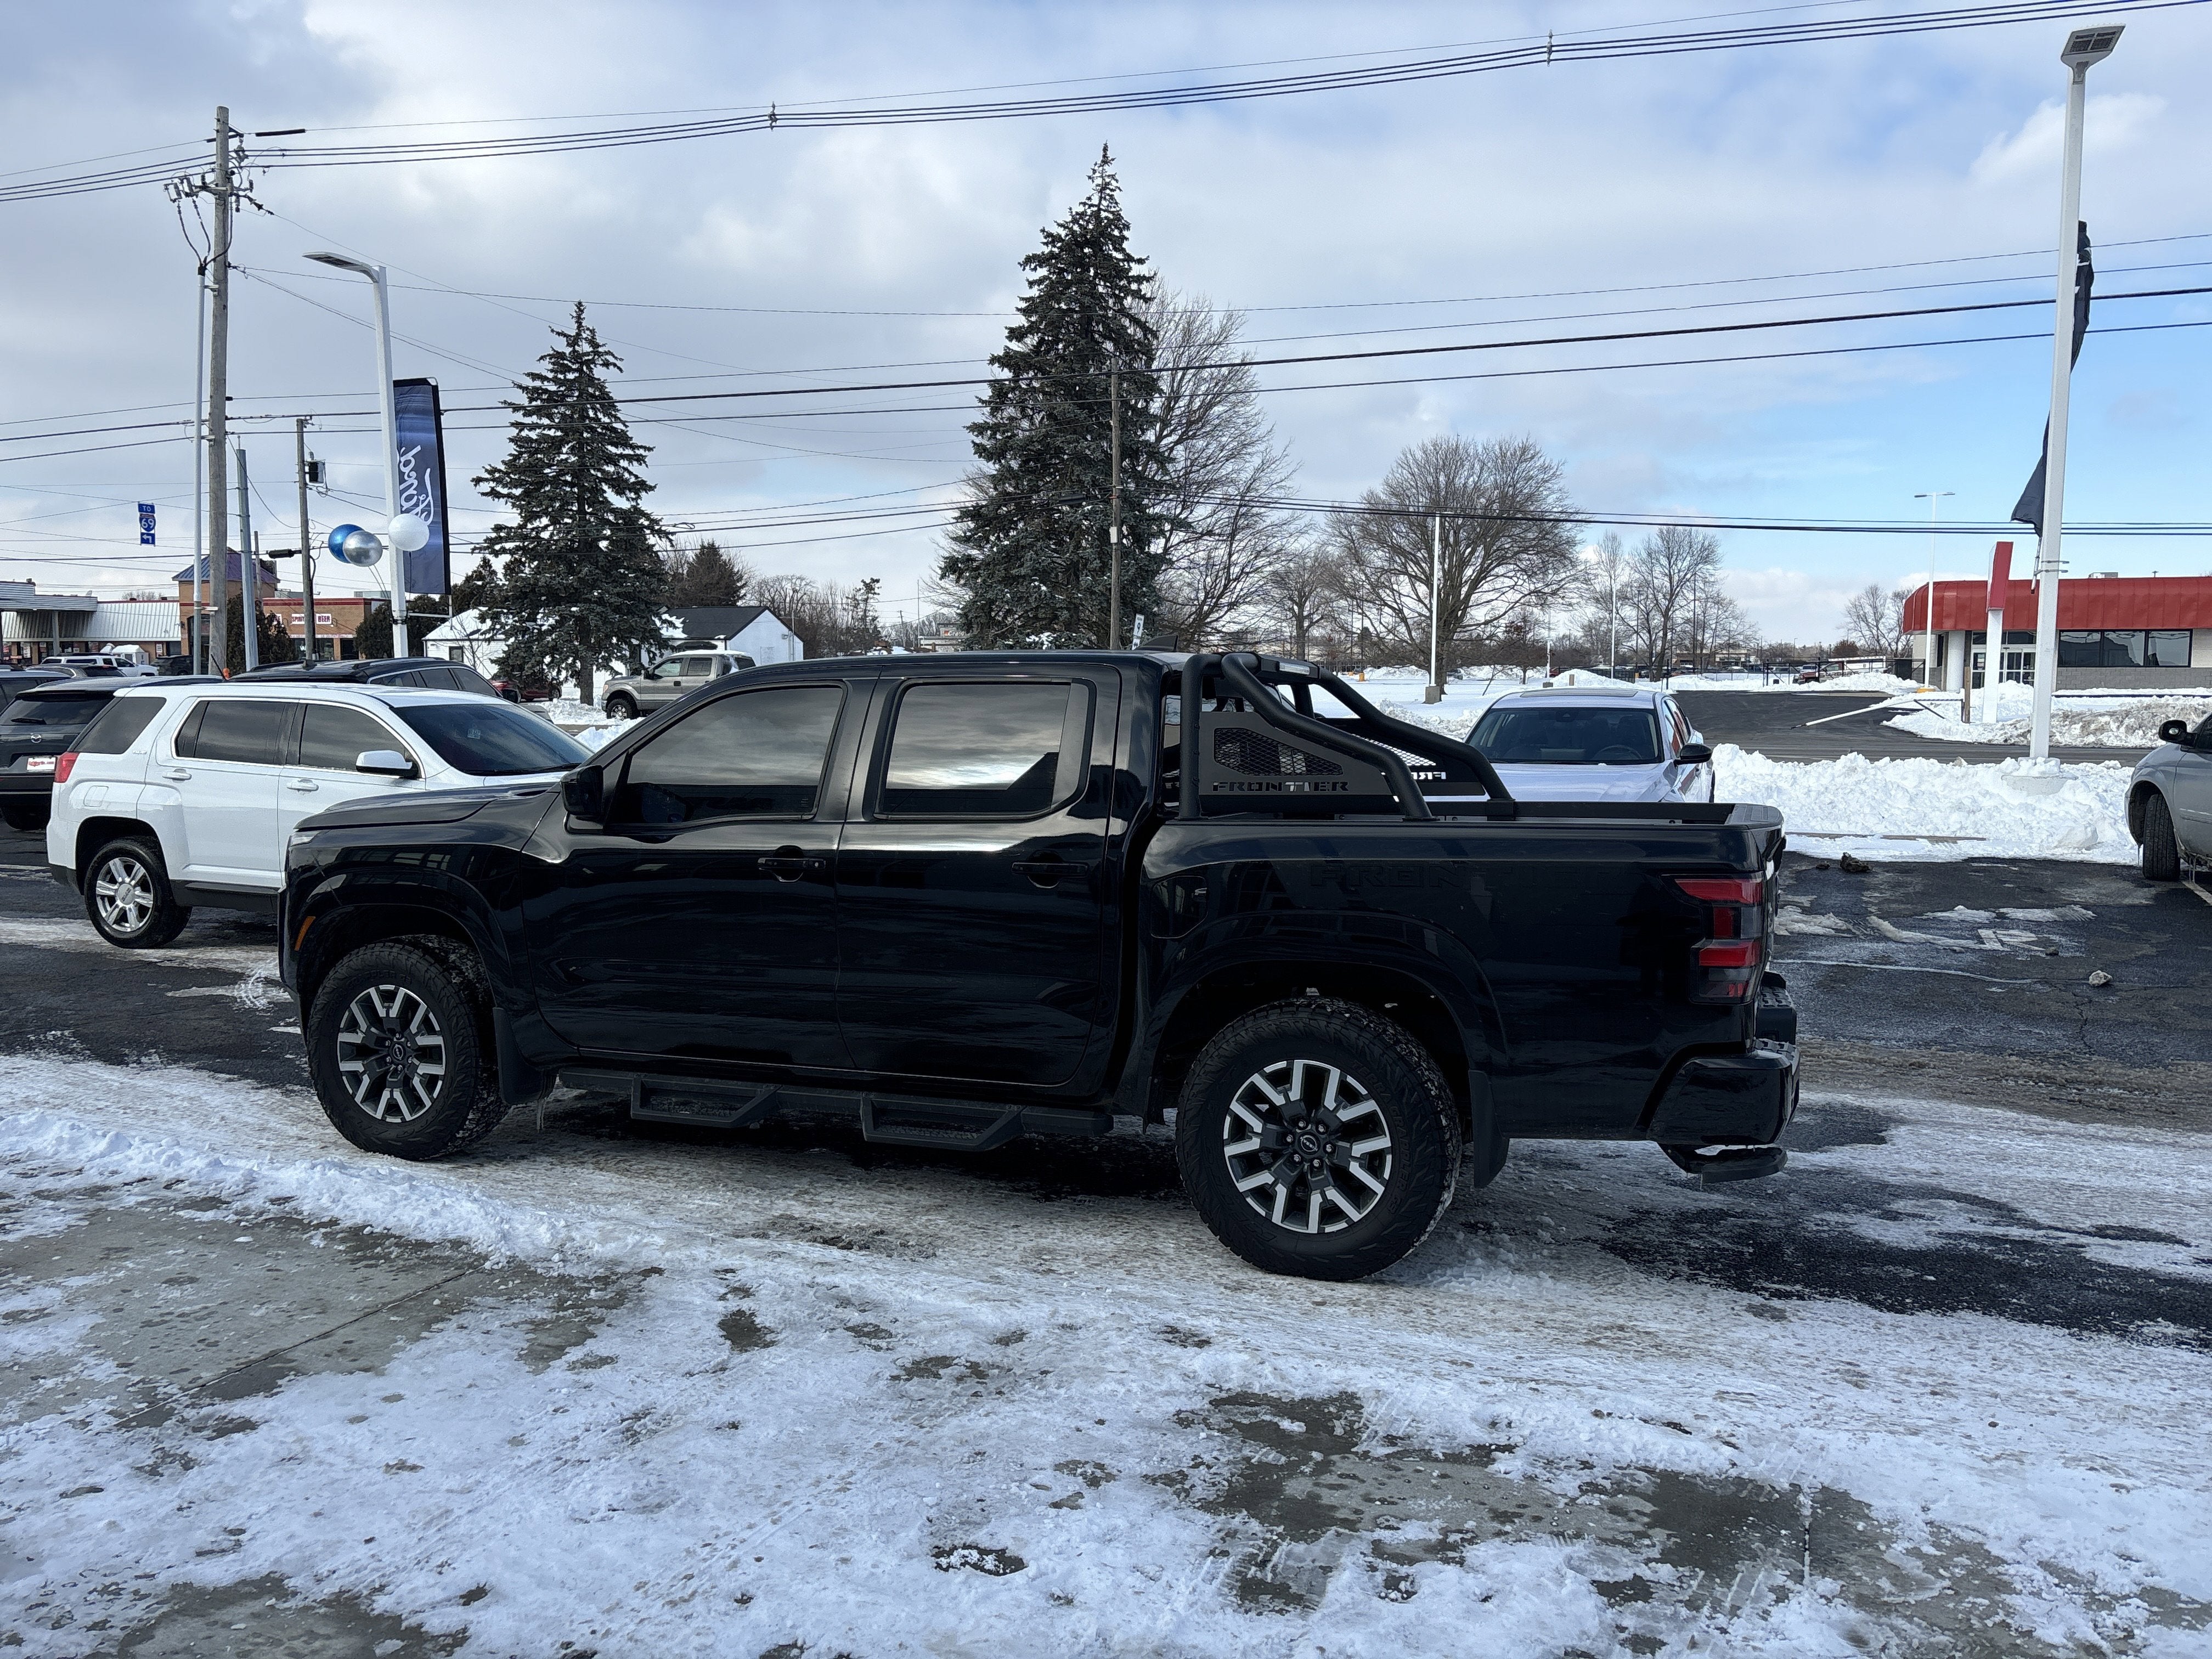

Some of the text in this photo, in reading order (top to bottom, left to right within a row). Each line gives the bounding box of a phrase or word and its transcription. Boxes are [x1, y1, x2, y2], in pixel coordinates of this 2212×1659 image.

[141, 518, 154, 529] 69
[1212, 781, 1350, 792] FRONTIER
[1389, 1106, 1412, 1193] GRAPPLER
